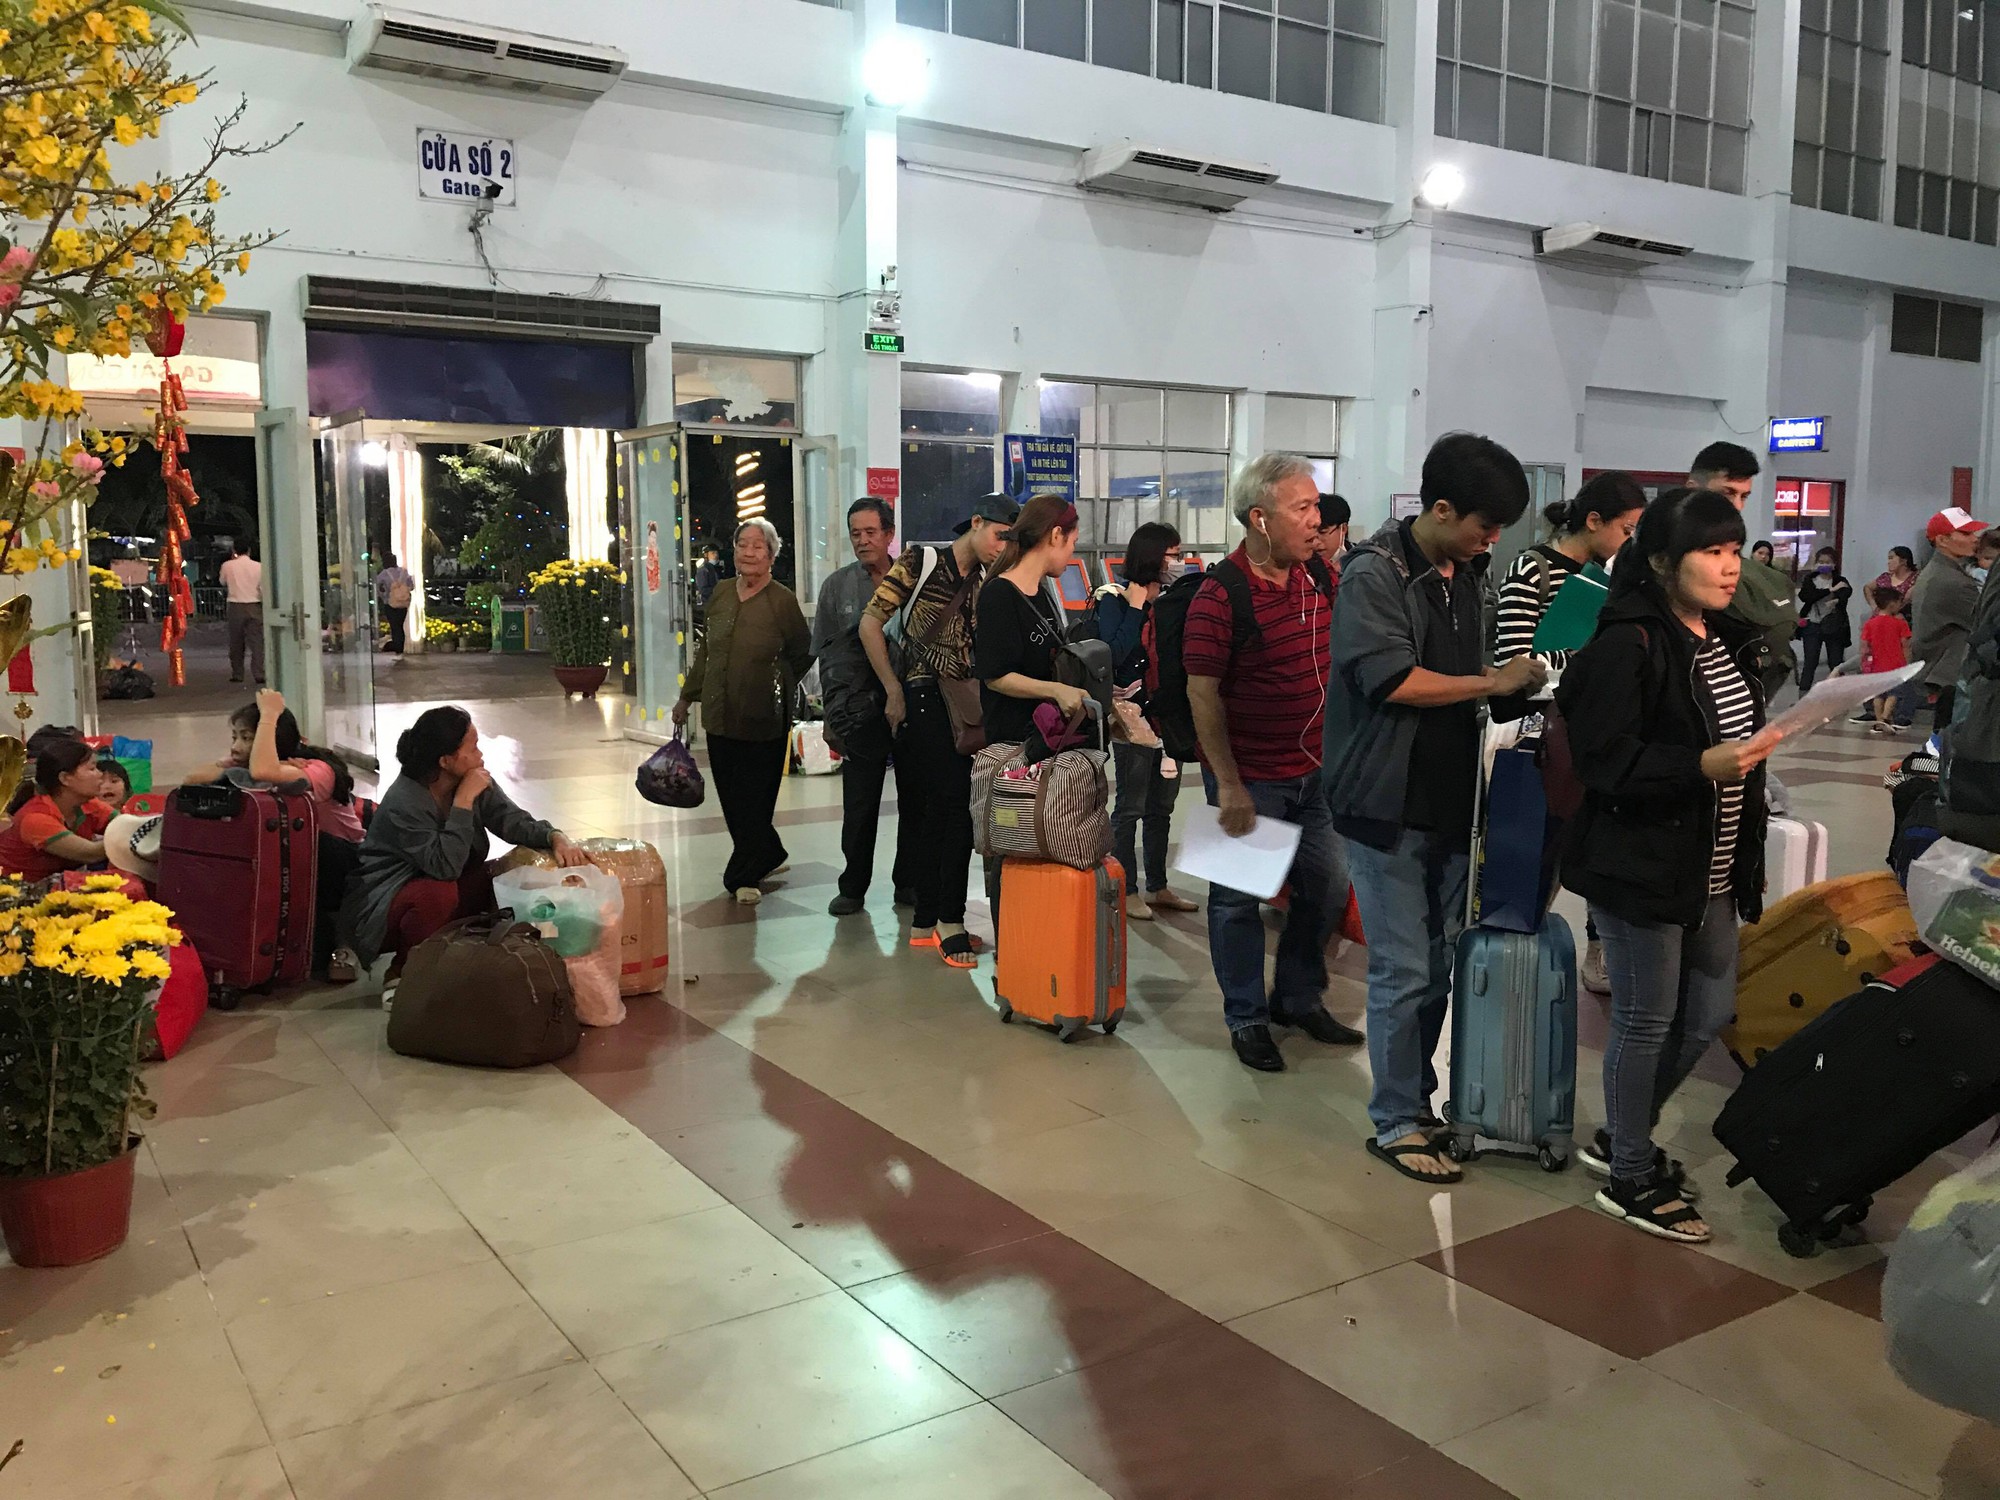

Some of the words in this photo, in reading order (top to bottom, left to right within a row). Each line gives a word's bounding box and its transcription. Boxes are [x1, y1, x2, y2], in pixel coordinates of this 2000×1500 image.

[422, 133, 462, 173] CỬA
[467, 139, 492, 177] SỐ
[500, 149, 512, 179] 2
[442, 178, 481, 197] Gate
[873, 335, 896, 344] EXIT
[1778, 438, 1815, 447] CANTEEN
